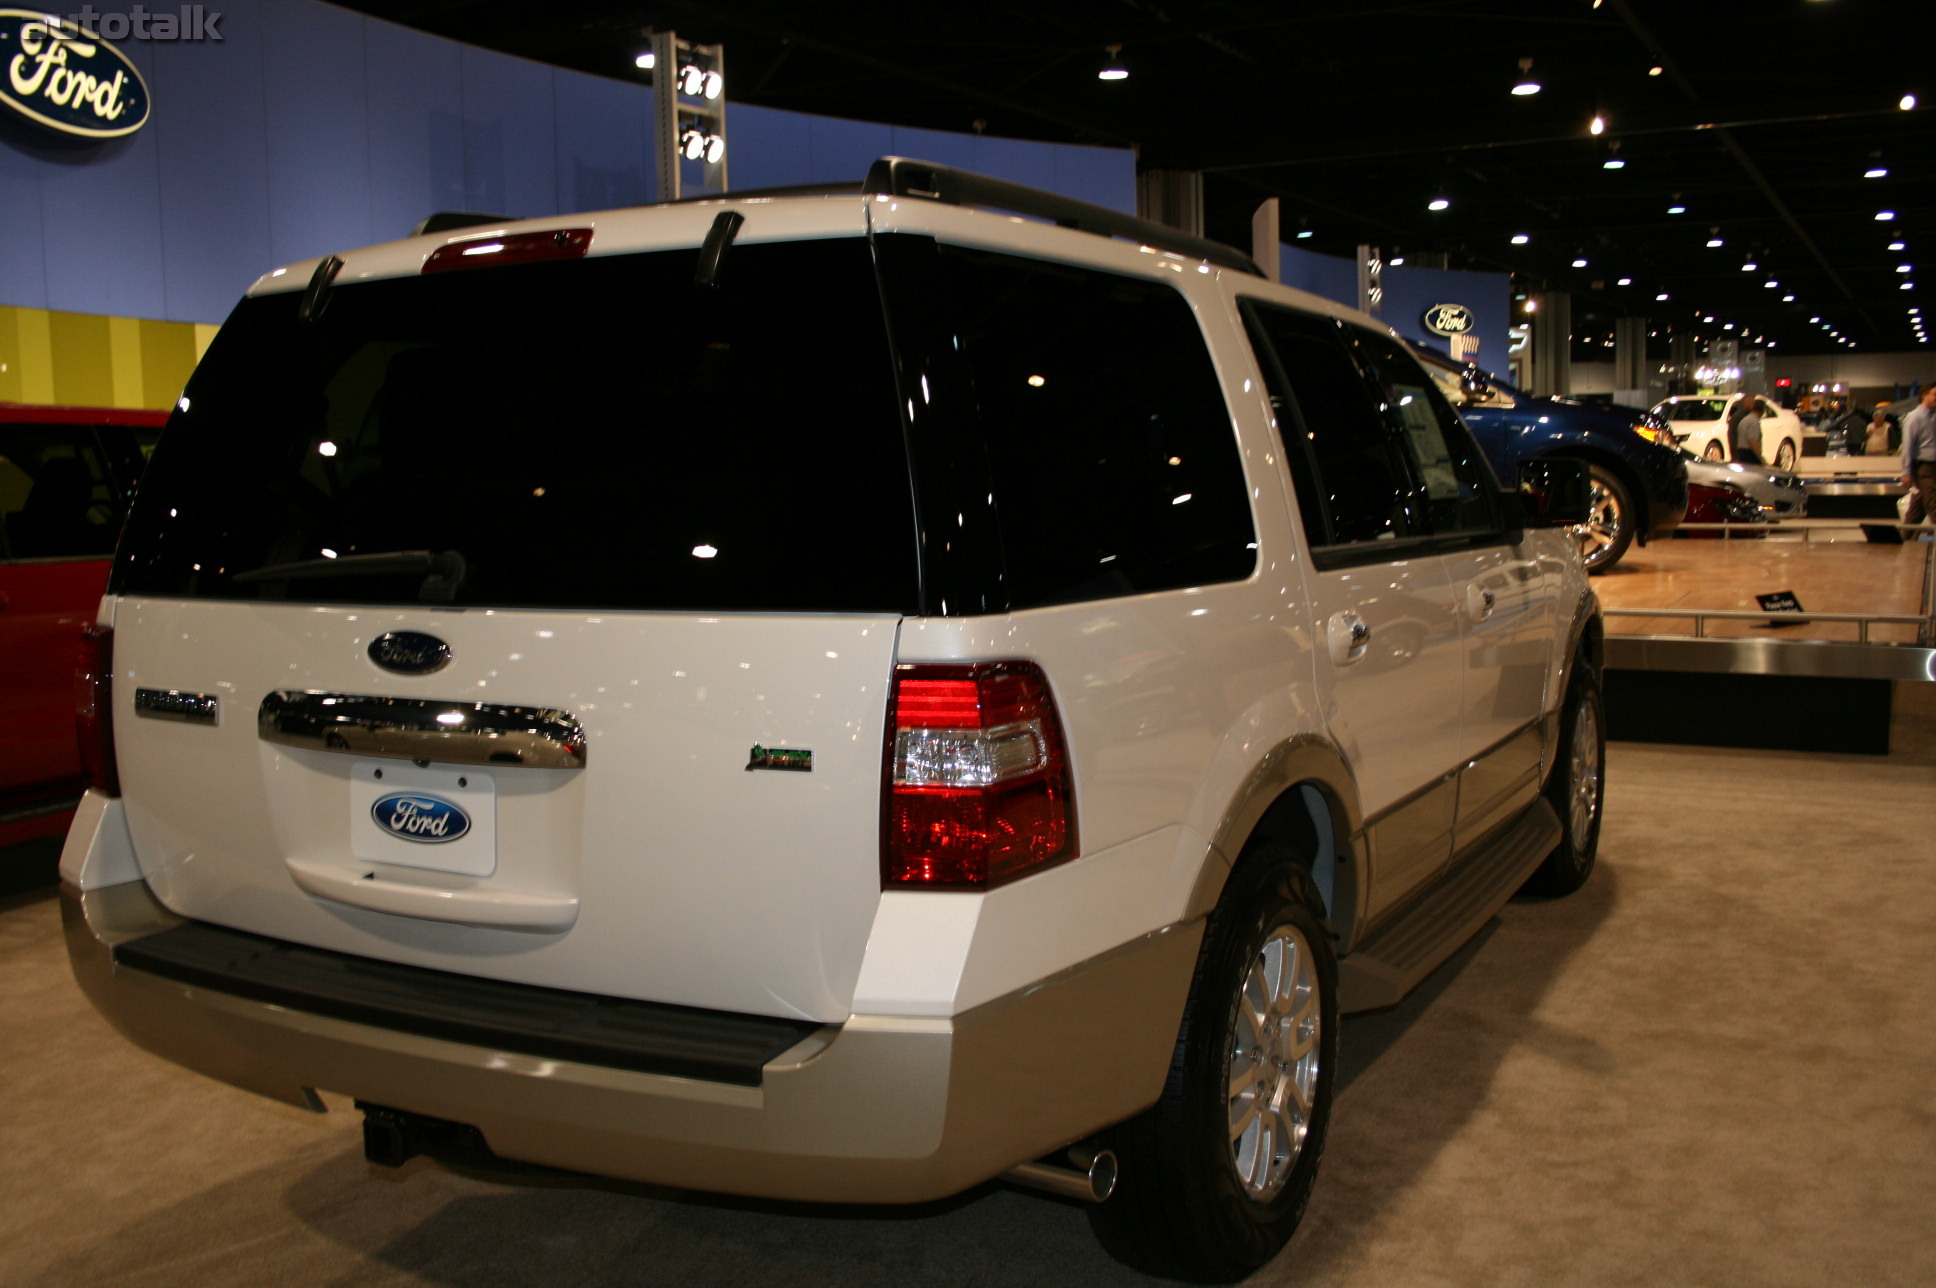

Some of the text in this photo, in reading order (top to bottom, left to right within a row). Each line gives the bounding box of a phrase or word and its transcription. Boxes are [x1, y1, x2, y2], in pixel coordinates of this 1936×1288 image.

[9, 22, 124, 120] Ford
[1436, 306, 1467, 331] Ford
[390, 798, 450, 837] Ford
